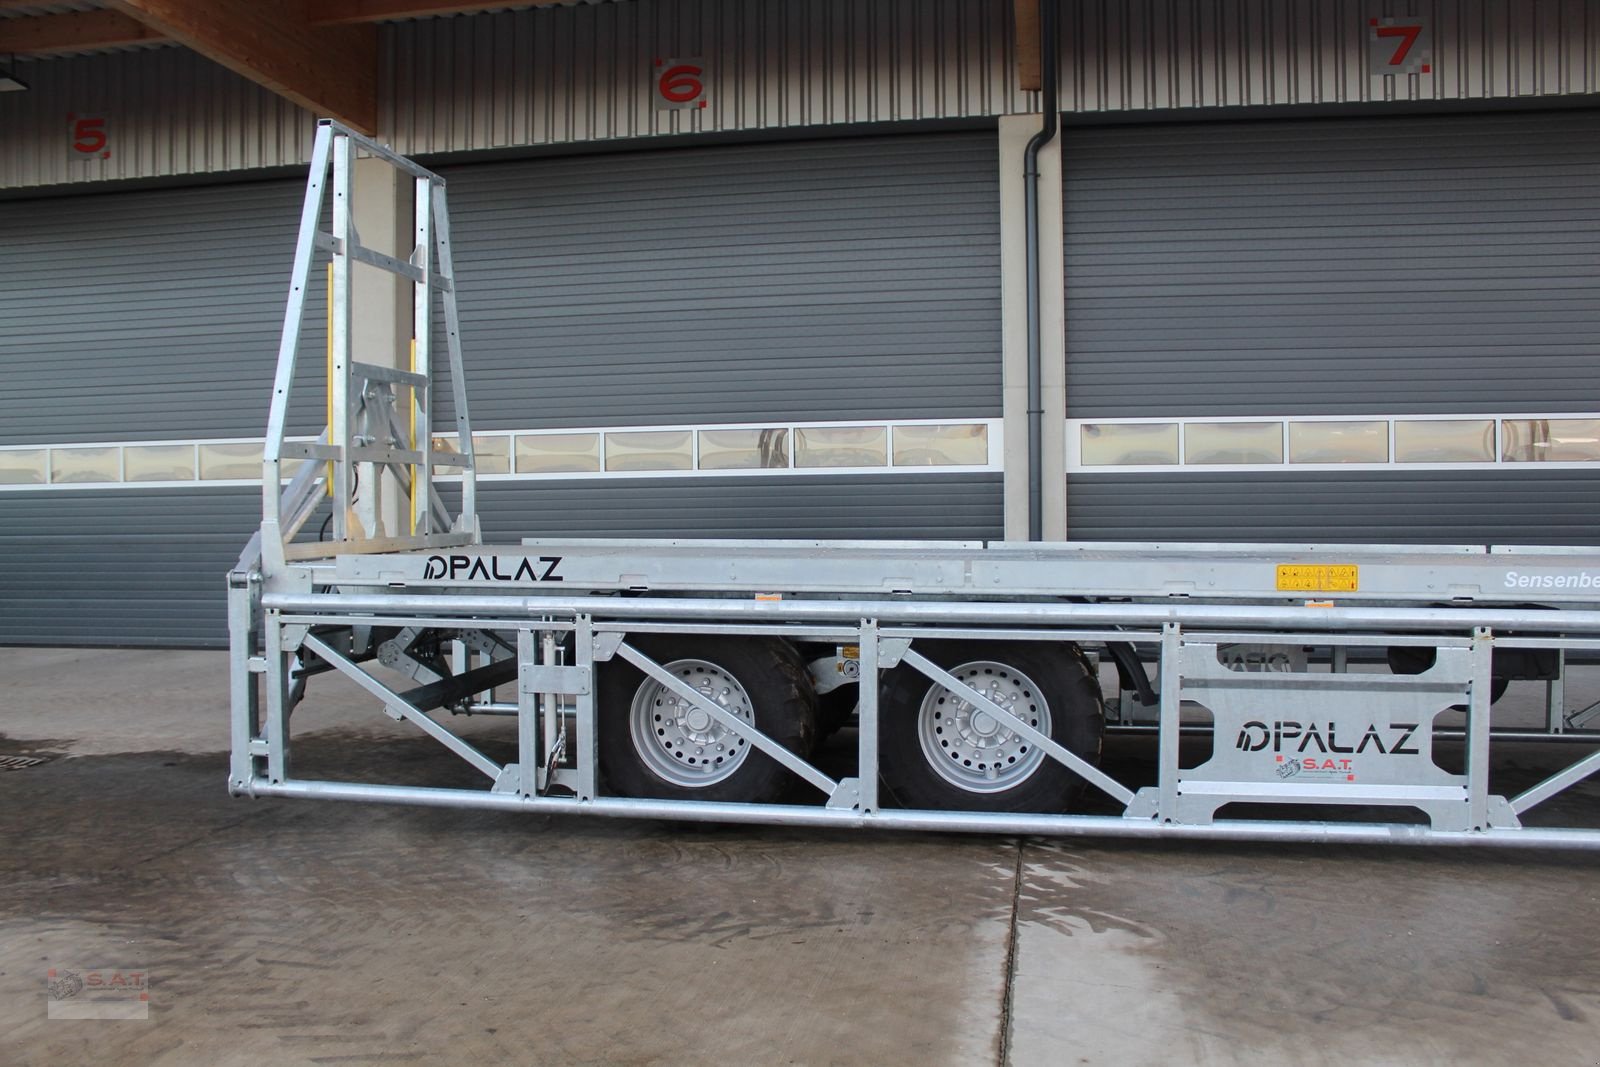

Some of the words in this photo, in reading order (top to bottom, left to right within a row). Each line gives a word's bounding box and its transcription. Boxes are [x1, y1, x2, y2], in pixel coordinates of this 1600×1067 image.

[1376, 25, 1423, 65] 7
[659, 65, 703, 103] 6
[73, 118, 106, 152] 5
[1504, 571, 1600, 588] Sensenbe
